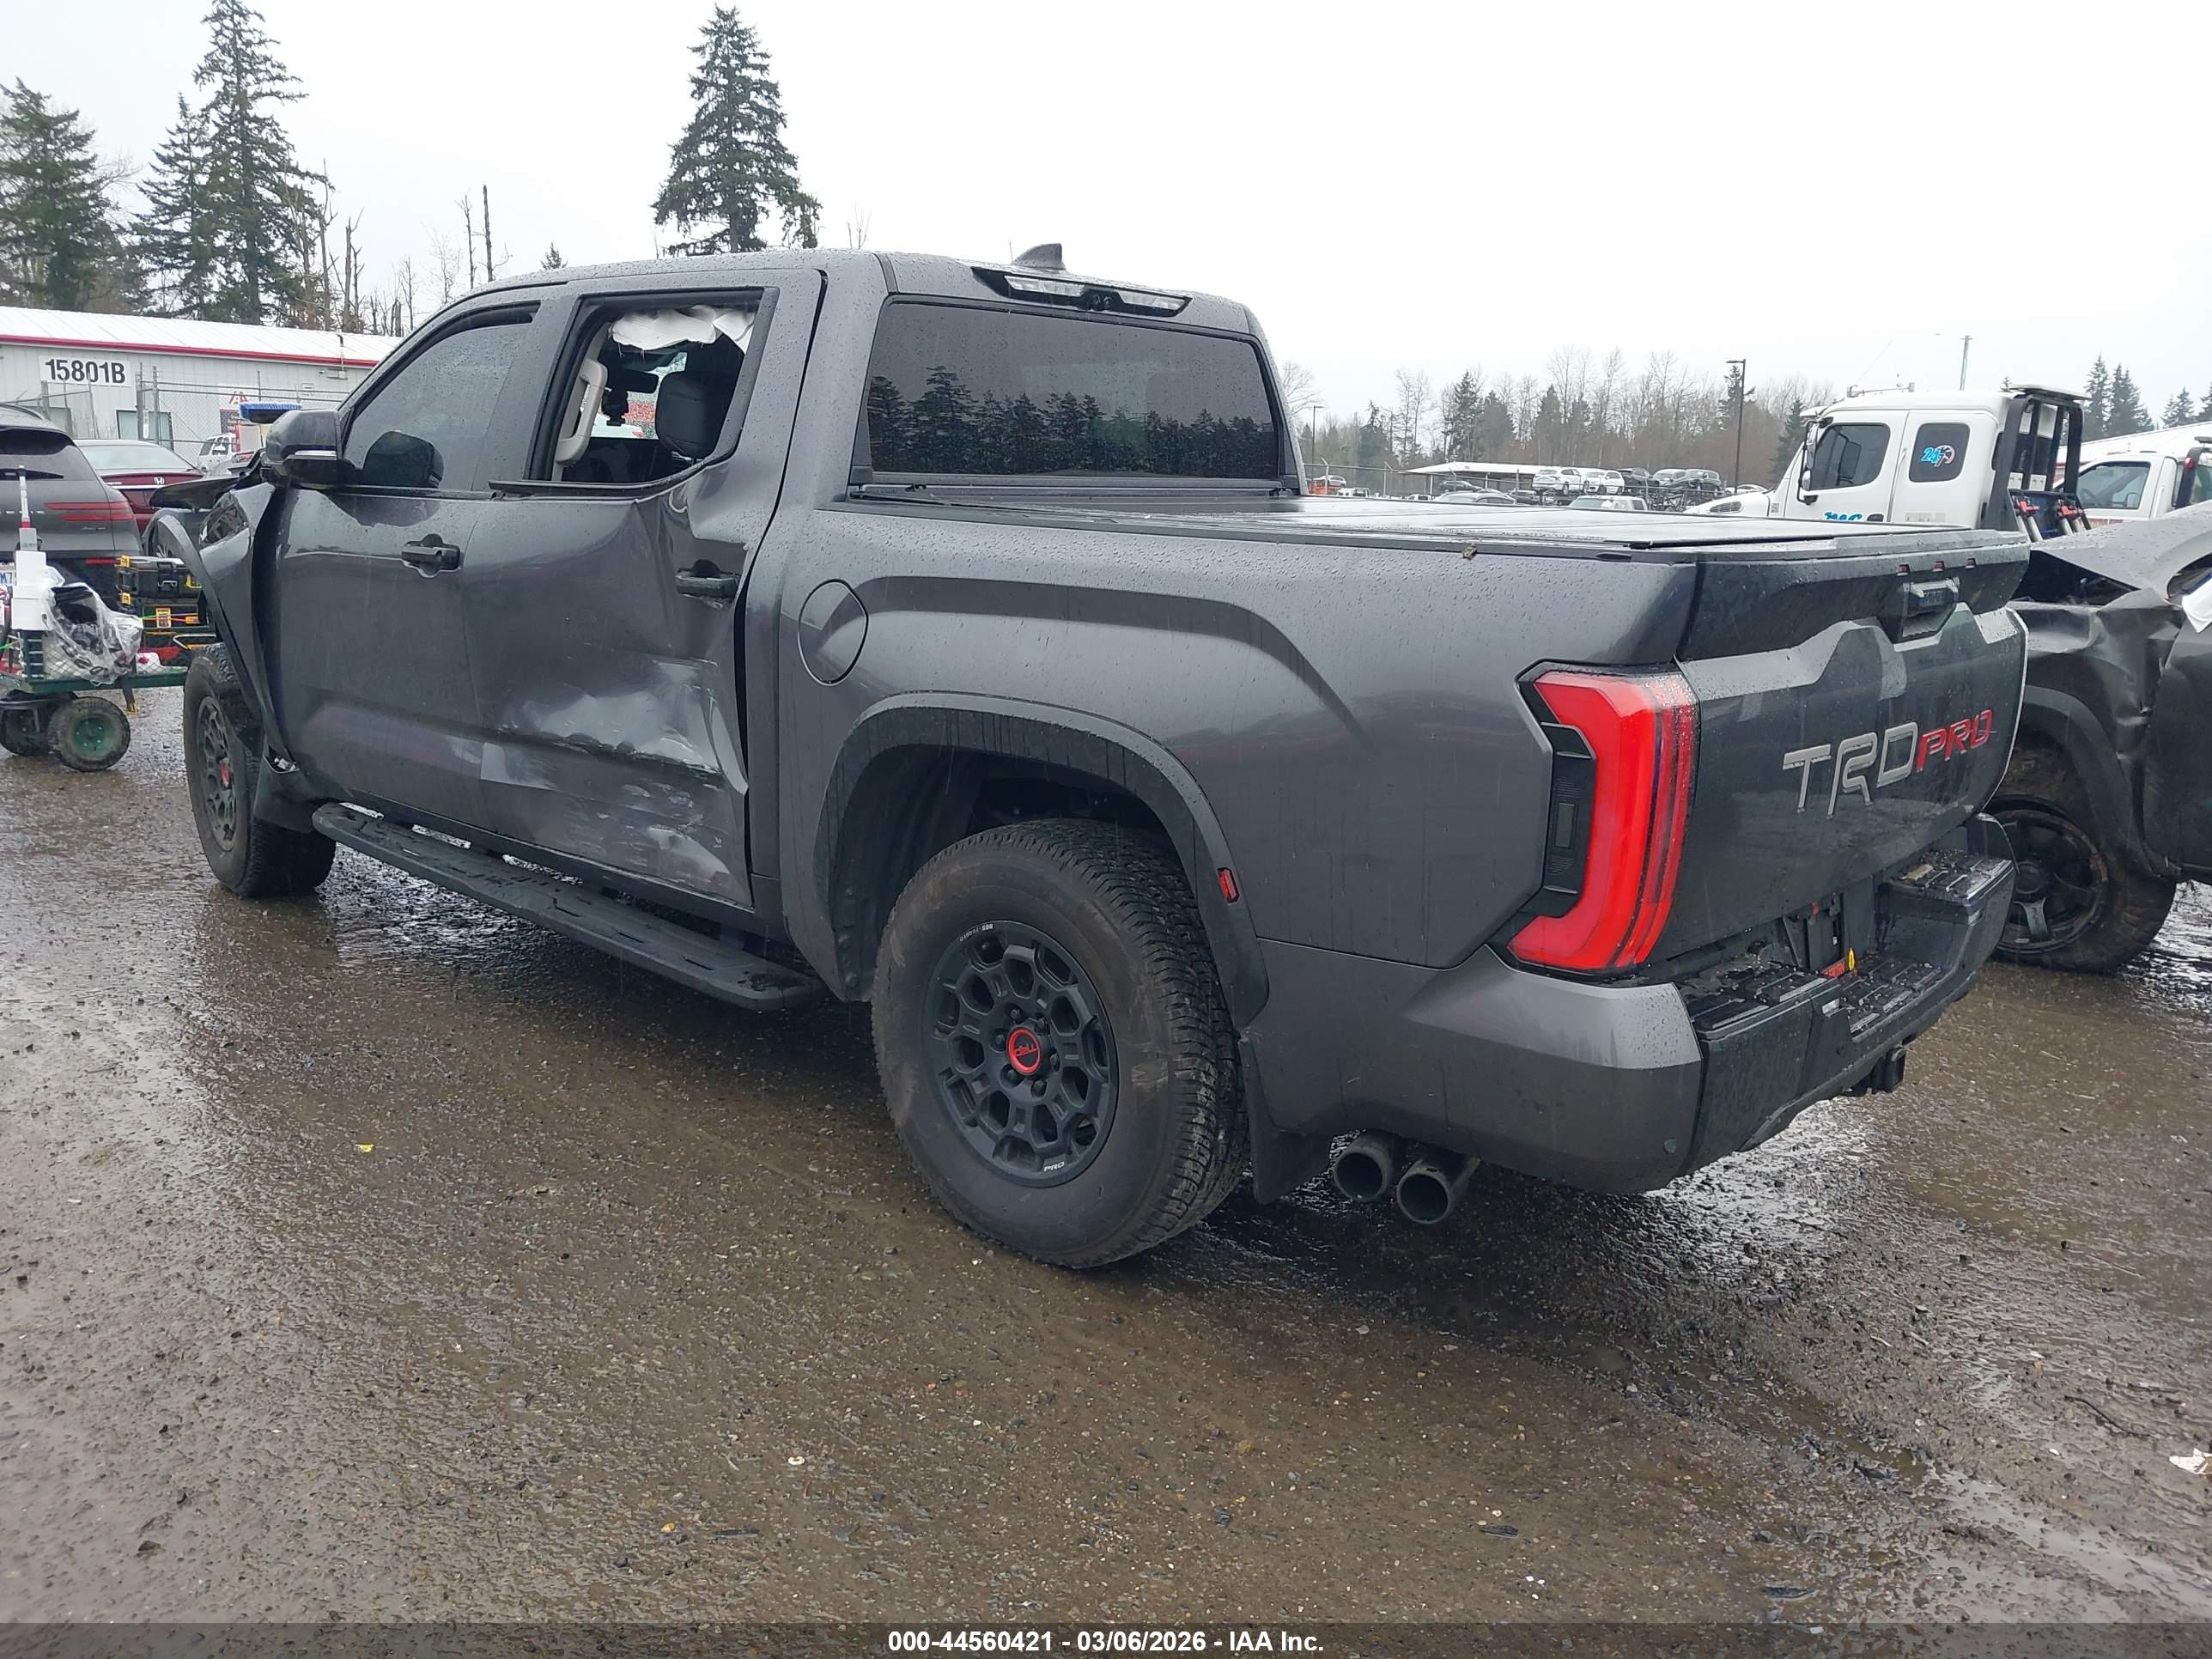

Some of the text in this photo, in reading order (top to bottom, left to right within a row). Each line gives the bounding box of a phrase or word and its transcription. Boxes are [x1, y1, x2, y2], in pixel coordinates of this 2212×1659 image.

[45, 358, 126, 384] 15801B
[1782, 708, 1993, 817] TRD PRO
[1043, 1161, 1065, 1172] PRO
